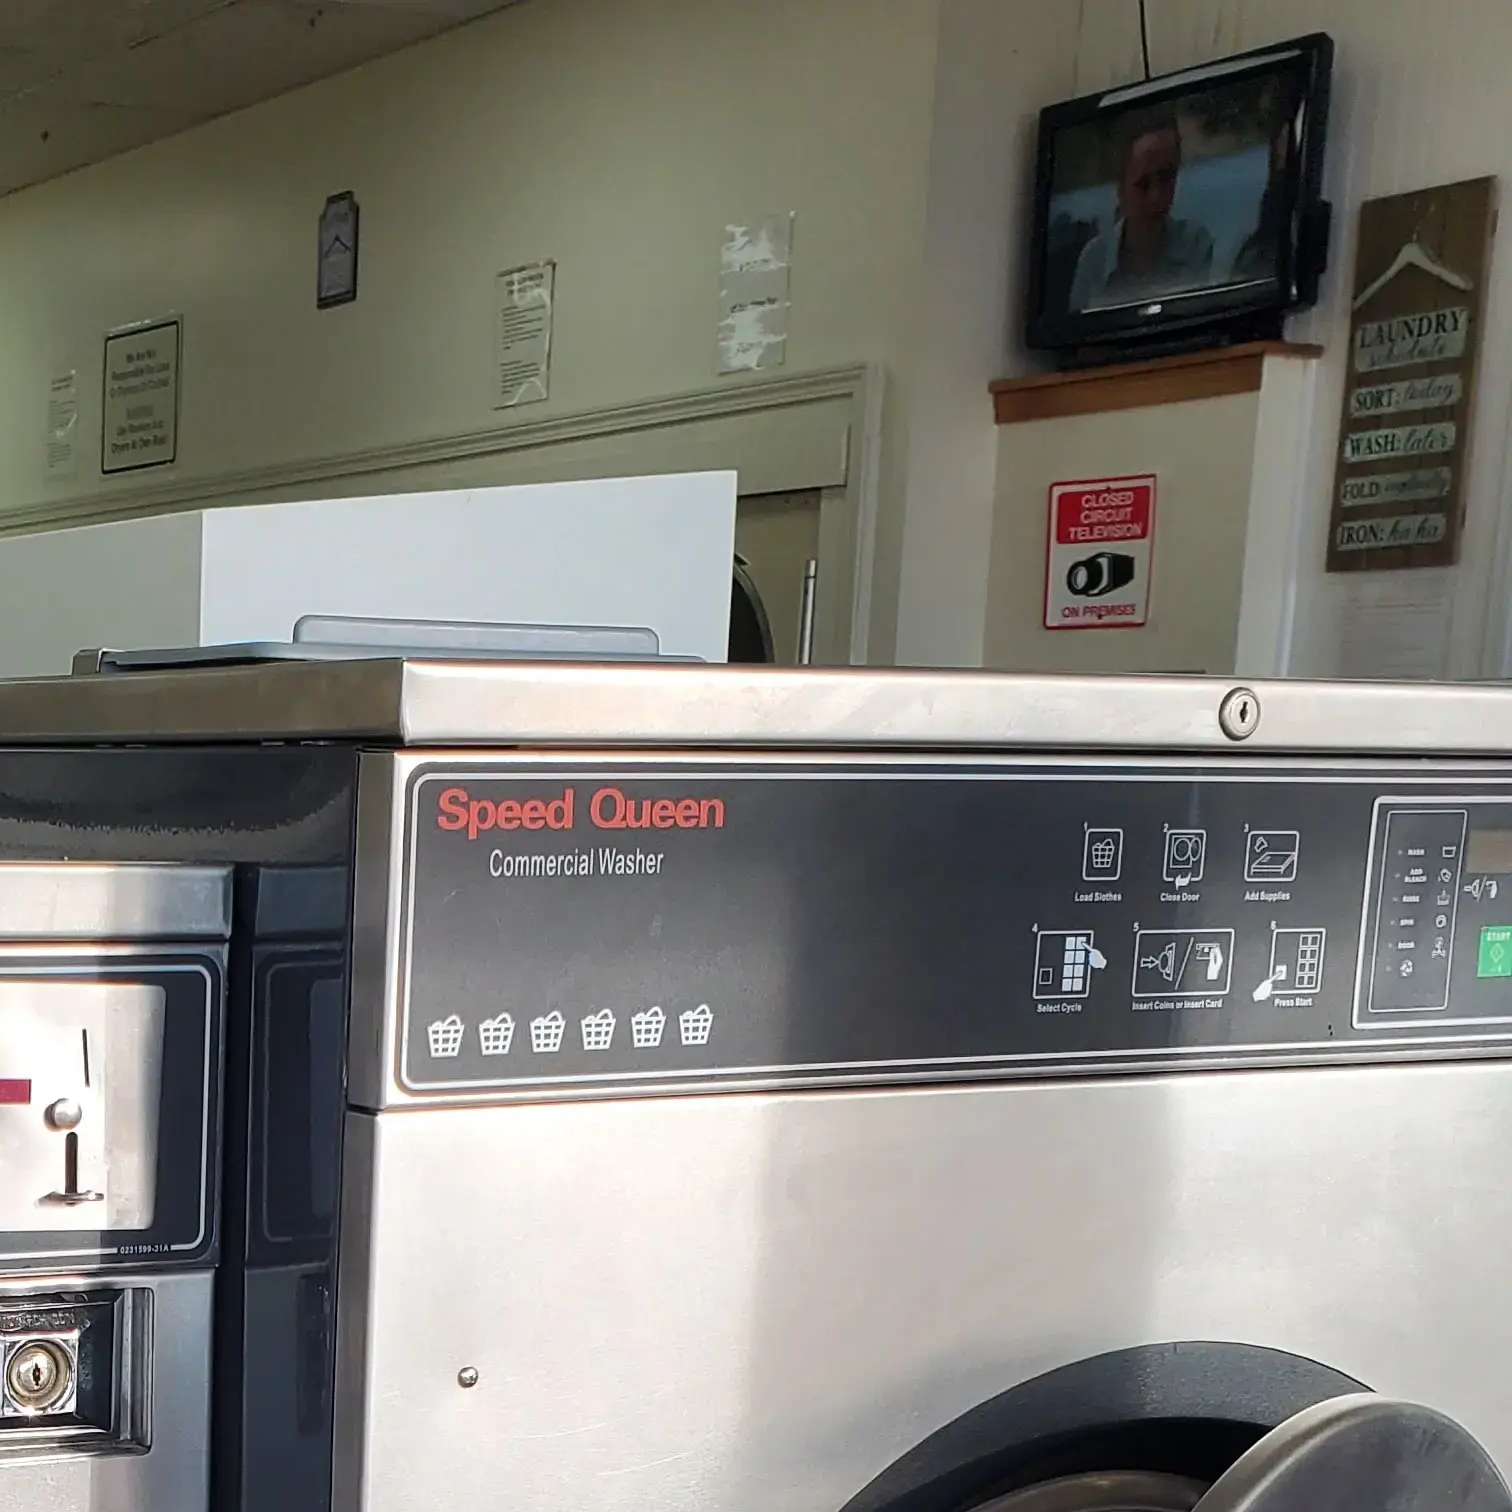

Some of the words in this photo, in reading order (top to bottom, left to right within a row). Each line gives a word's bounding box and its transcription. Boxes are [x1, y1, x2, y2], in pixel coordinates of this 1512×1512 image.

[1359, 310, 1465, 348] LAUNDRY
[1082, 492, 1134, 508] CLOSED
[1080, 508, 1133, 524] CIRCUIT
[1069, 524, 1142, 540] TELEVISION
[1062, 607, 1079, 618] ON
[1083, 604, 1136, 617] PREMISES
[438, 788, 574, 840] Speed
[590, 787, 724, 829] Queen
[1084, 822, 1088, 831] 1
[1163, 823, 1169, 832] 2
[1244, 823, 1249, 832] 3
[489, 849, 594, 877] Commercial
[599, 848, 663, 875] Washer
[1075, 892, 1093, 901] Load
[1160, 893, 1180, 901] Close
[1182, 892, 1199, 901] Door
[1244, 892, 1260, 900] Add
[1261, 891, 1290, 901] Supplies
[1032, 924, 1038, 933] 4
[1133, 922, 1139, 932] 5
[1037, 1003, 1060, 1012] Select
[1062, 1003, 1082, 1012] Cycle
[1132, 1002, 1153, 1010] Insert
[1154, 1001, 1174, 1010] Coins
[1184, 1000, 1204, 1010] Insert
[1205, 1000, 1222, 1008] Card
[1275, 998, 1294, 1007] Press
[1296, 998, 1312, 1006] Start
